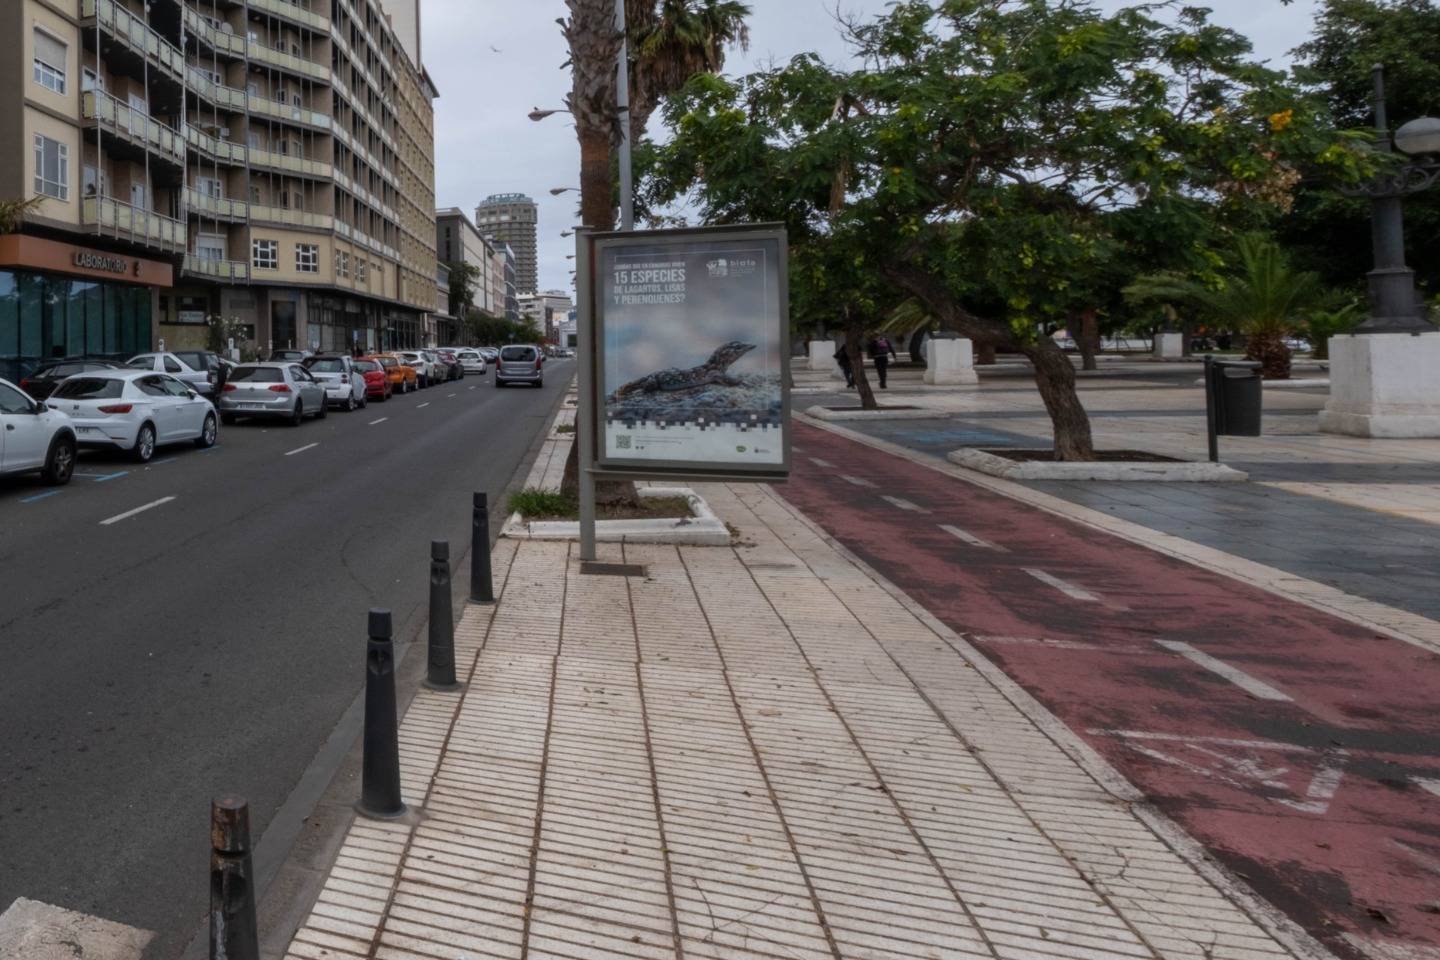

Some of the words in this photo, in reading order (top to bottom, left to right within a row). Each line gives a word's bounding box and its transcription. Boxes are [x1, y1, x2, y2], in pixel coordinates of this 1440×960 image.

[74, 252, 129, 273] LABORATORIO
[614, 270, 628, 284] 15
[631, 269, 686, 283] ESPECIES
[614, 285, 623, 294] DE
[664, 283, 686, 293] LISAS
[614, 295, 620, 305] Y
